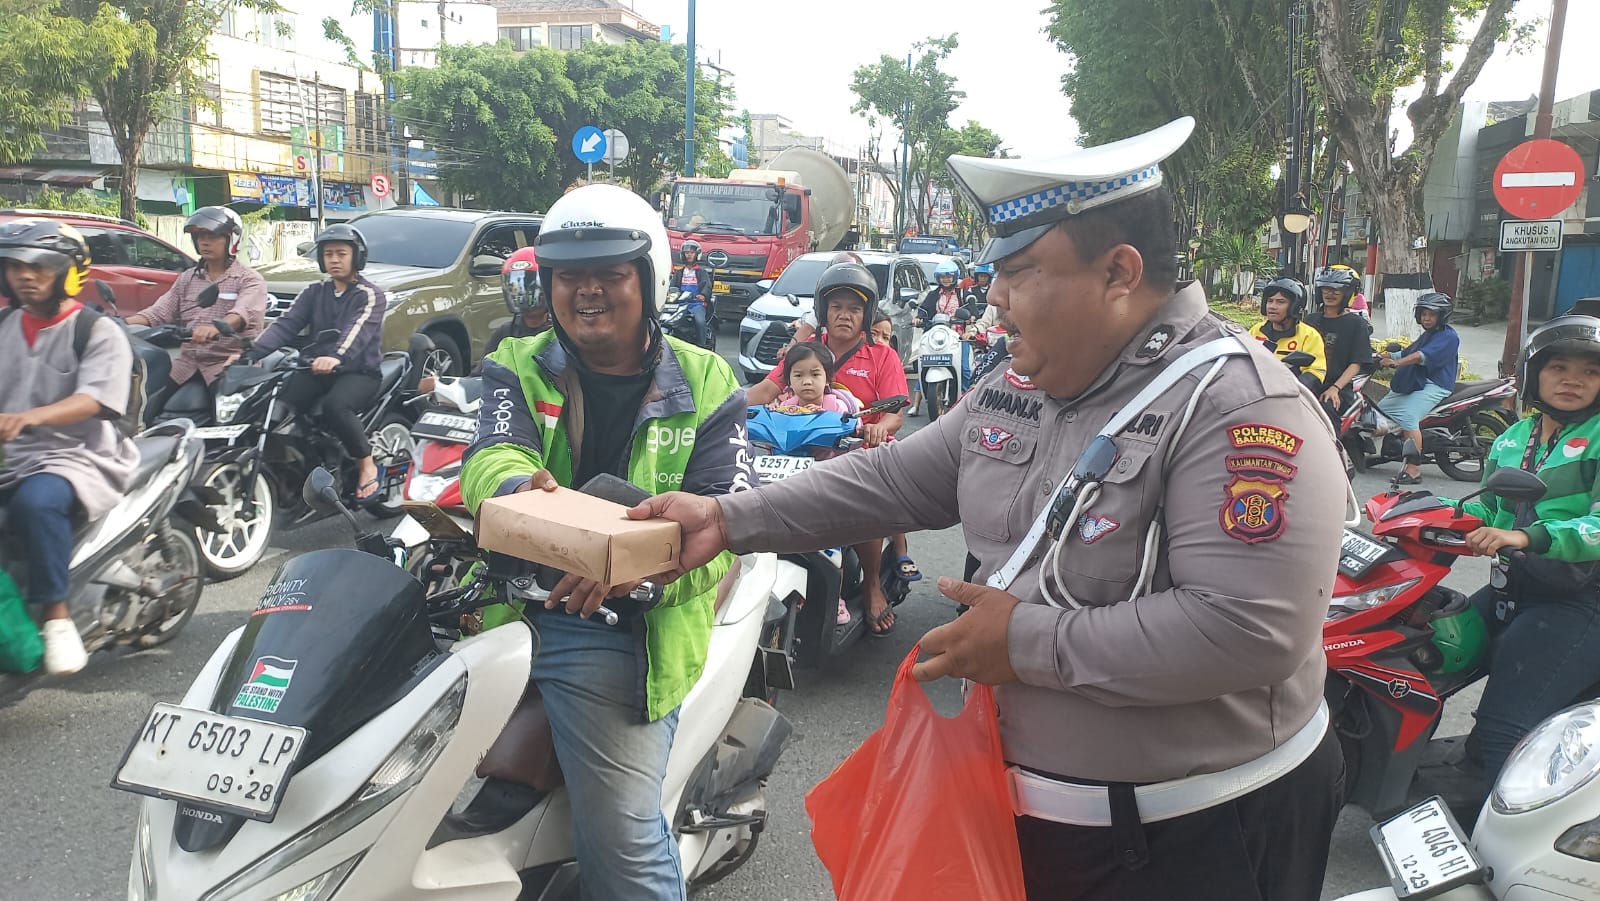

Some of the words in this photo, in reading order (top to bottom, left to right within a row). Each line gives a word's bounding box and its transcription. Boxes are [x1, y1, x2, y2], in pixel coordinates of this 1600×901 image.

[1514, 225, 1549, 236] KHUSUS
[1505, 237, 1538, 245] ANGKUTAN
[1540, 236, 1557, 245] KOTA
[1232, 427, 1297, 447] POLRESTA
[1235, 435, 1294, 453] BALIKPAPAN
[760, 457, 790, 470] 5257
[794, 459, 811, 470] LS
[1231, 457, 1273, 468] KALIMANTAN
[1272, 461, 1292, 474] TIMUR
[1324, 639, 1366, 651] HONDA
[240, 685, 250, 694] WE
[249, 686, 268, 696] STAND
[268, 689, 286, 699] WITH
[234, 693, 281, 712] PALESTINE
[143, 711, 182, 744] KT
[188, 720, 251, 758] 6503
[258, 732, 295, 766] LP
[181, 807, 224, 824] HONDA
[1409, 804, 1439, 824] KT
[1421, 826, 1458, 858] 4046
